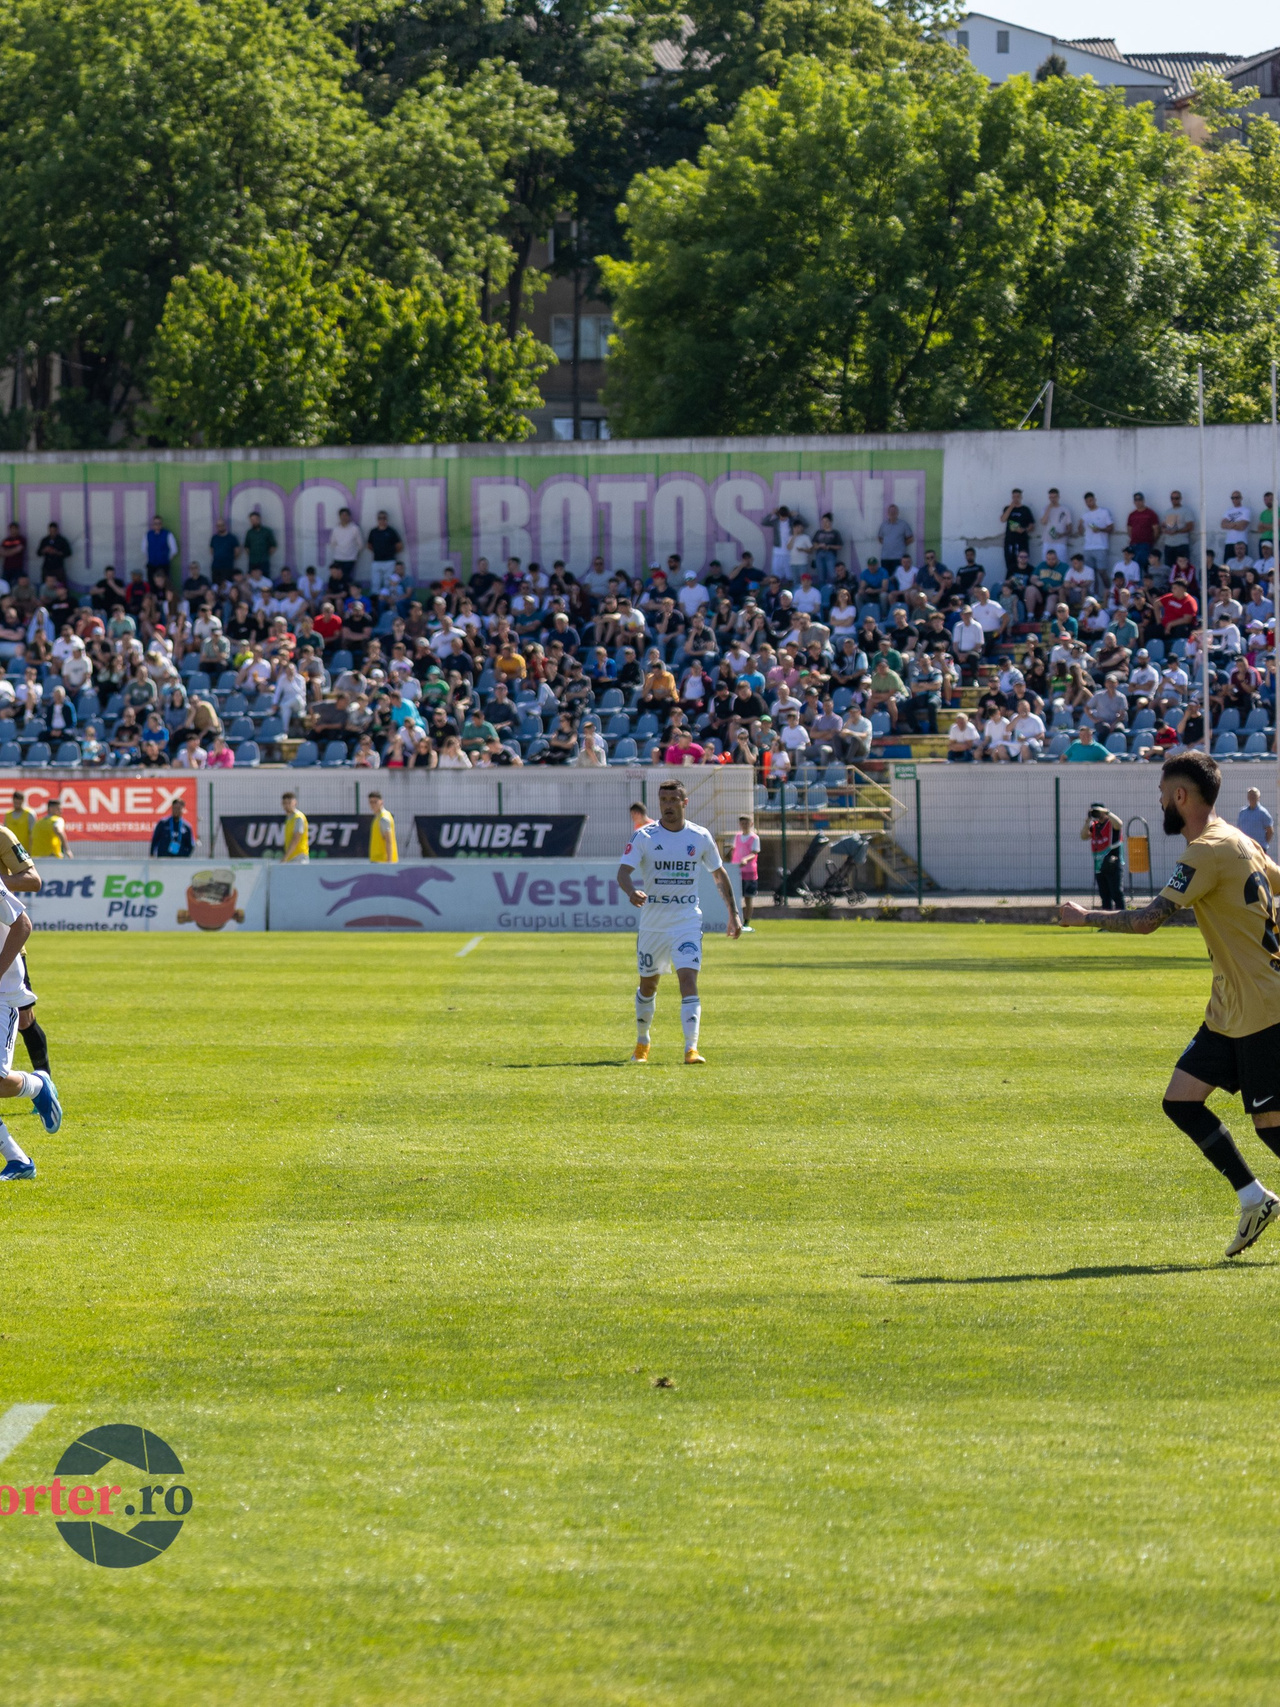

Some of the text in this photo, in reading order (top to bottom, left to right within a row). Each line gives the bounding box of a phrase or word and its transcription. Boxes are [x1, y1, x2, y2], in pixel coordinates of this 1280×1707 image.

[86, 821, 157, 832] INDUSTRIAL
[245, 822, 359, 847] UNBET
[439, 822, 553, 848] UNIBET
[654, 861, 697, 871] UNIBET
[102, 875, 164, 899] Eco
[492, 871, 645, 907] Vestr
[108, 900, 158, 918] Plus
[31, 919, 128, 932] nteligente.ro
[498, 912, 637, 931] Grupul Elsaco
[639, 951, 653, 968] 30
